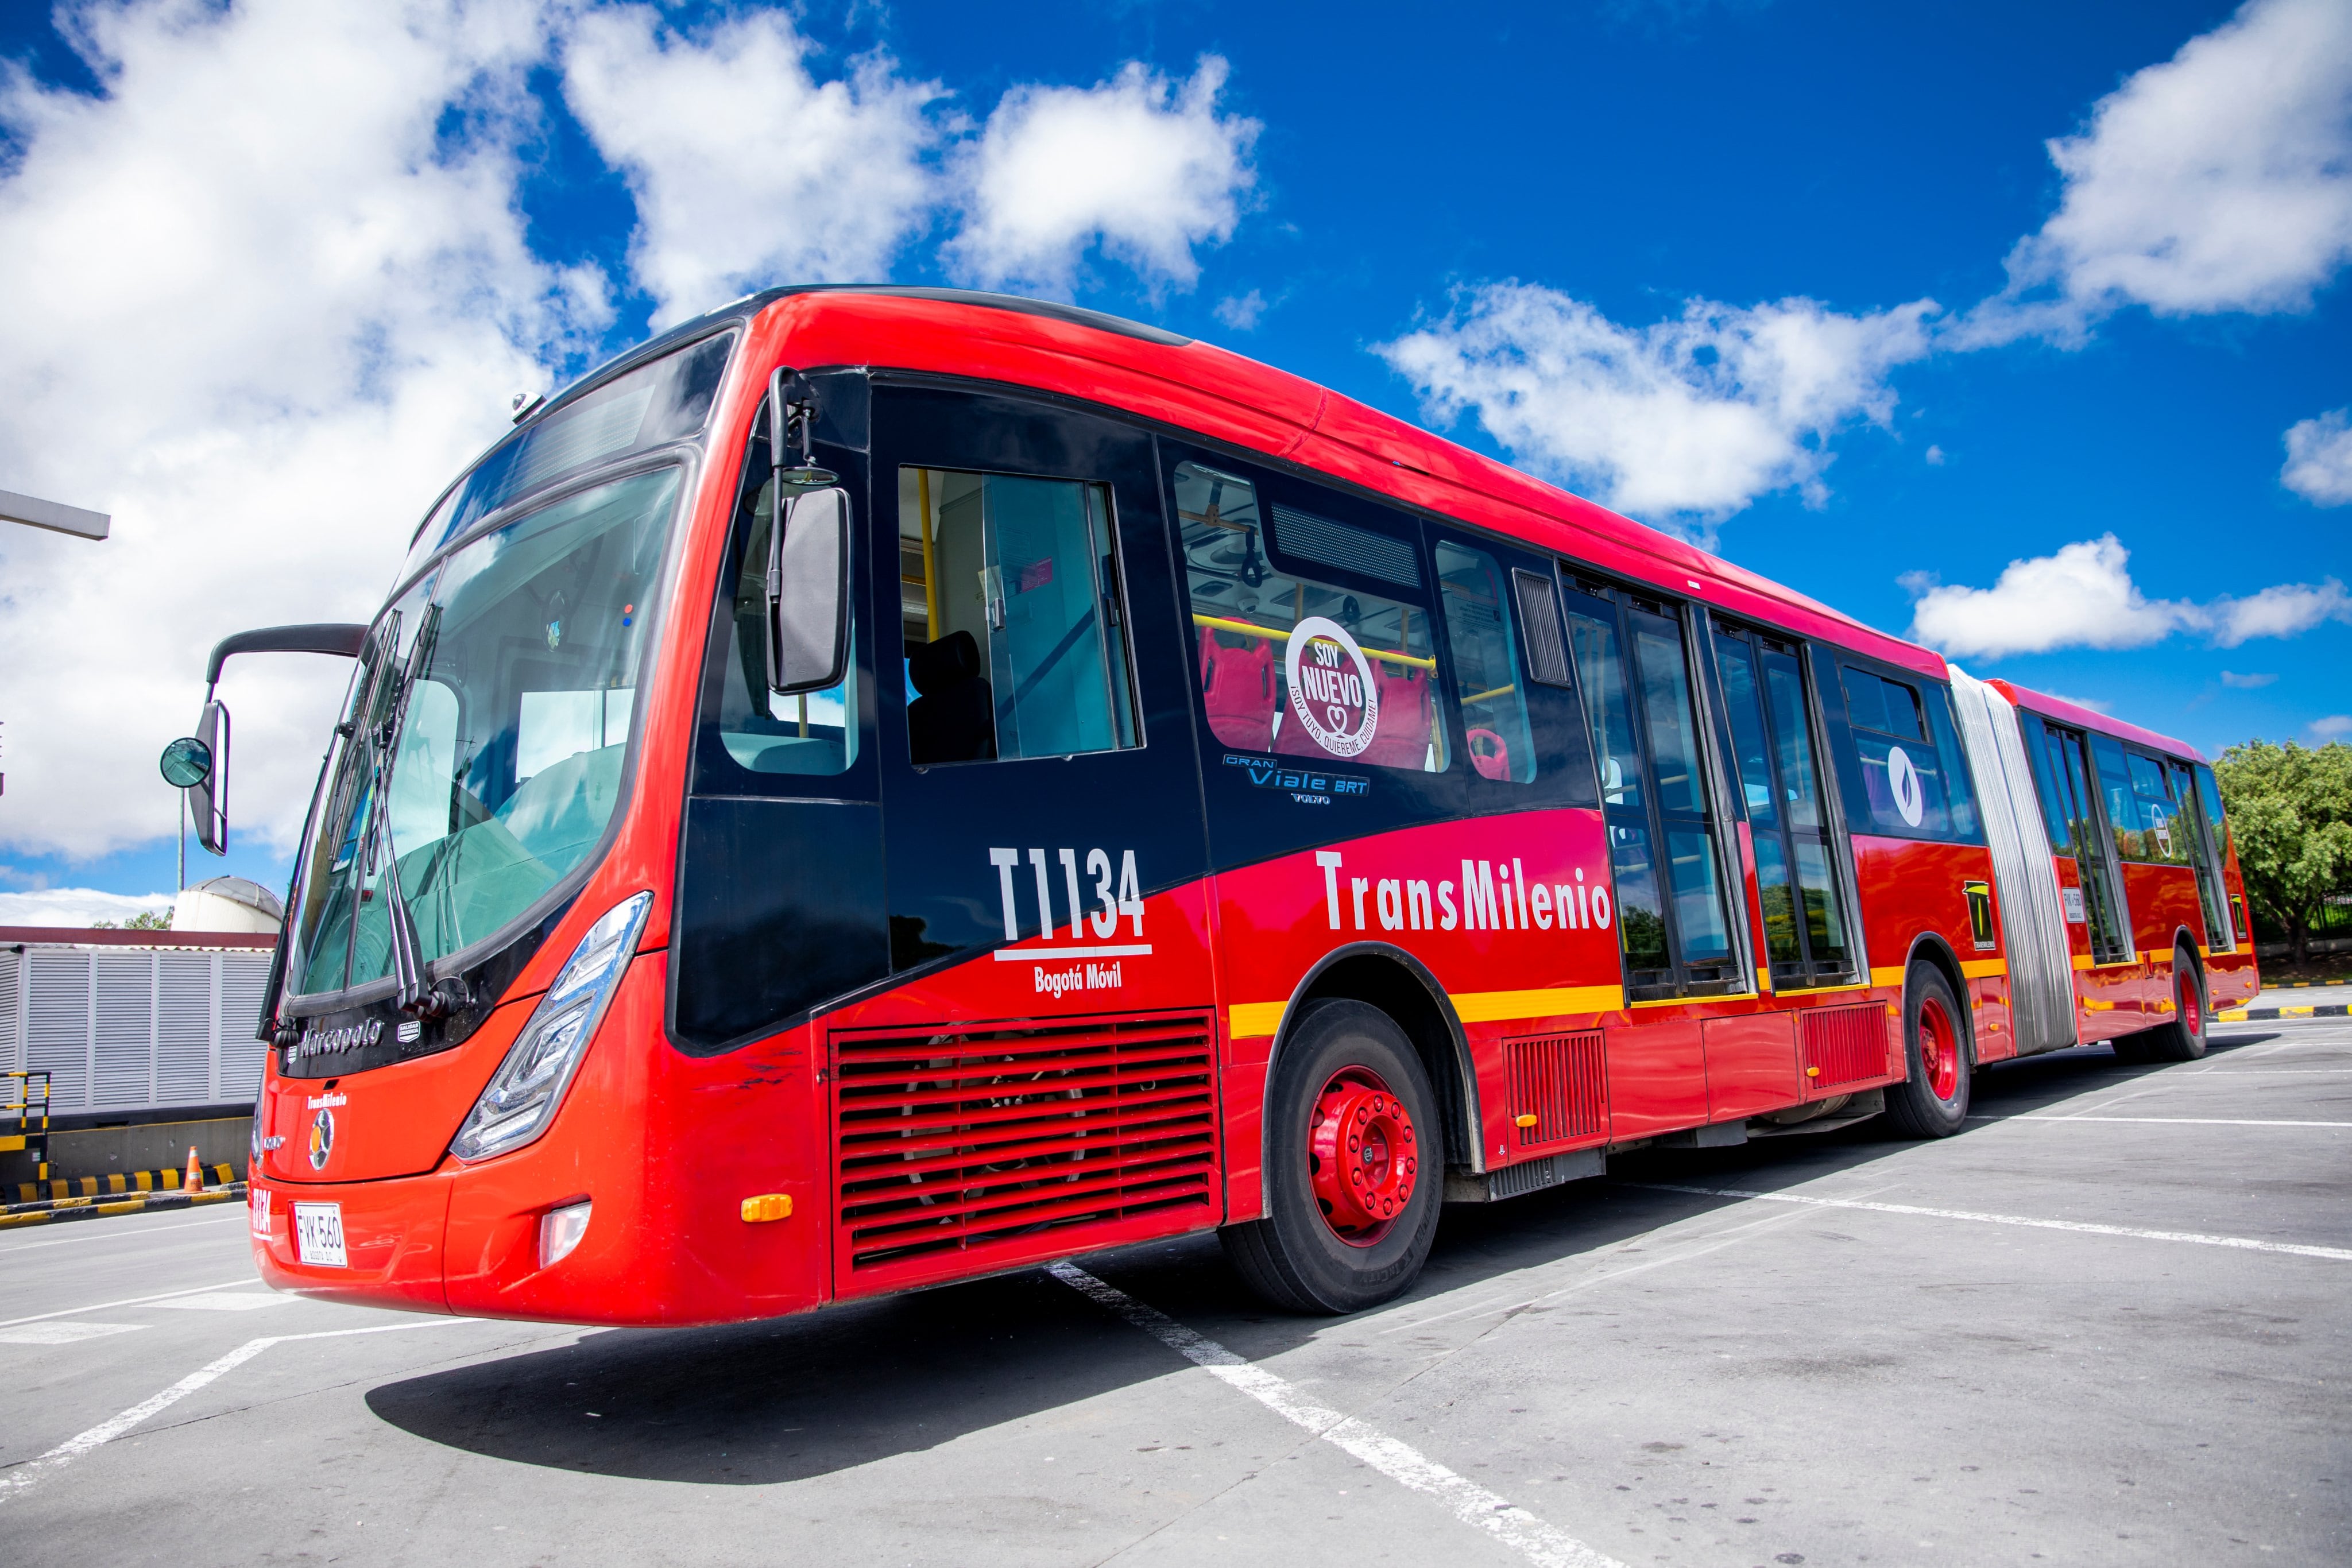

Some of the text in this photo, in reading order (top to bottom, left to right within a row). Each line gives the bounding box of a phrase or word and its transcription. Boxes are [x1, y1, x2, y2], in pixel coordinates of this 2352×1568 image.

[1314, 642, 1338, 668] SOY
[1302, 666, 1363, 708] NUEVO
[1302, 711, 1321, 744] TUYO,
[1324, 735, 1363, 755] QUIÉREME,
[1226, 757, 1274, 768] GRAN
[1249, 768, 1367, 793] Viale BRT
[1291, 793, 1330, 805] VOLVO
[989, 847, 1144, 940] T1134
[1316, 850, 1611, 931] TransMilenio
[1034, 961, 1121, 998] Bogotá Móvil
[400, 1023, 419, 1031] SALIDAS
[307, 1091, 347, 1110] TransMilenio
[297, 1215, 341, 1249] FVK 560
